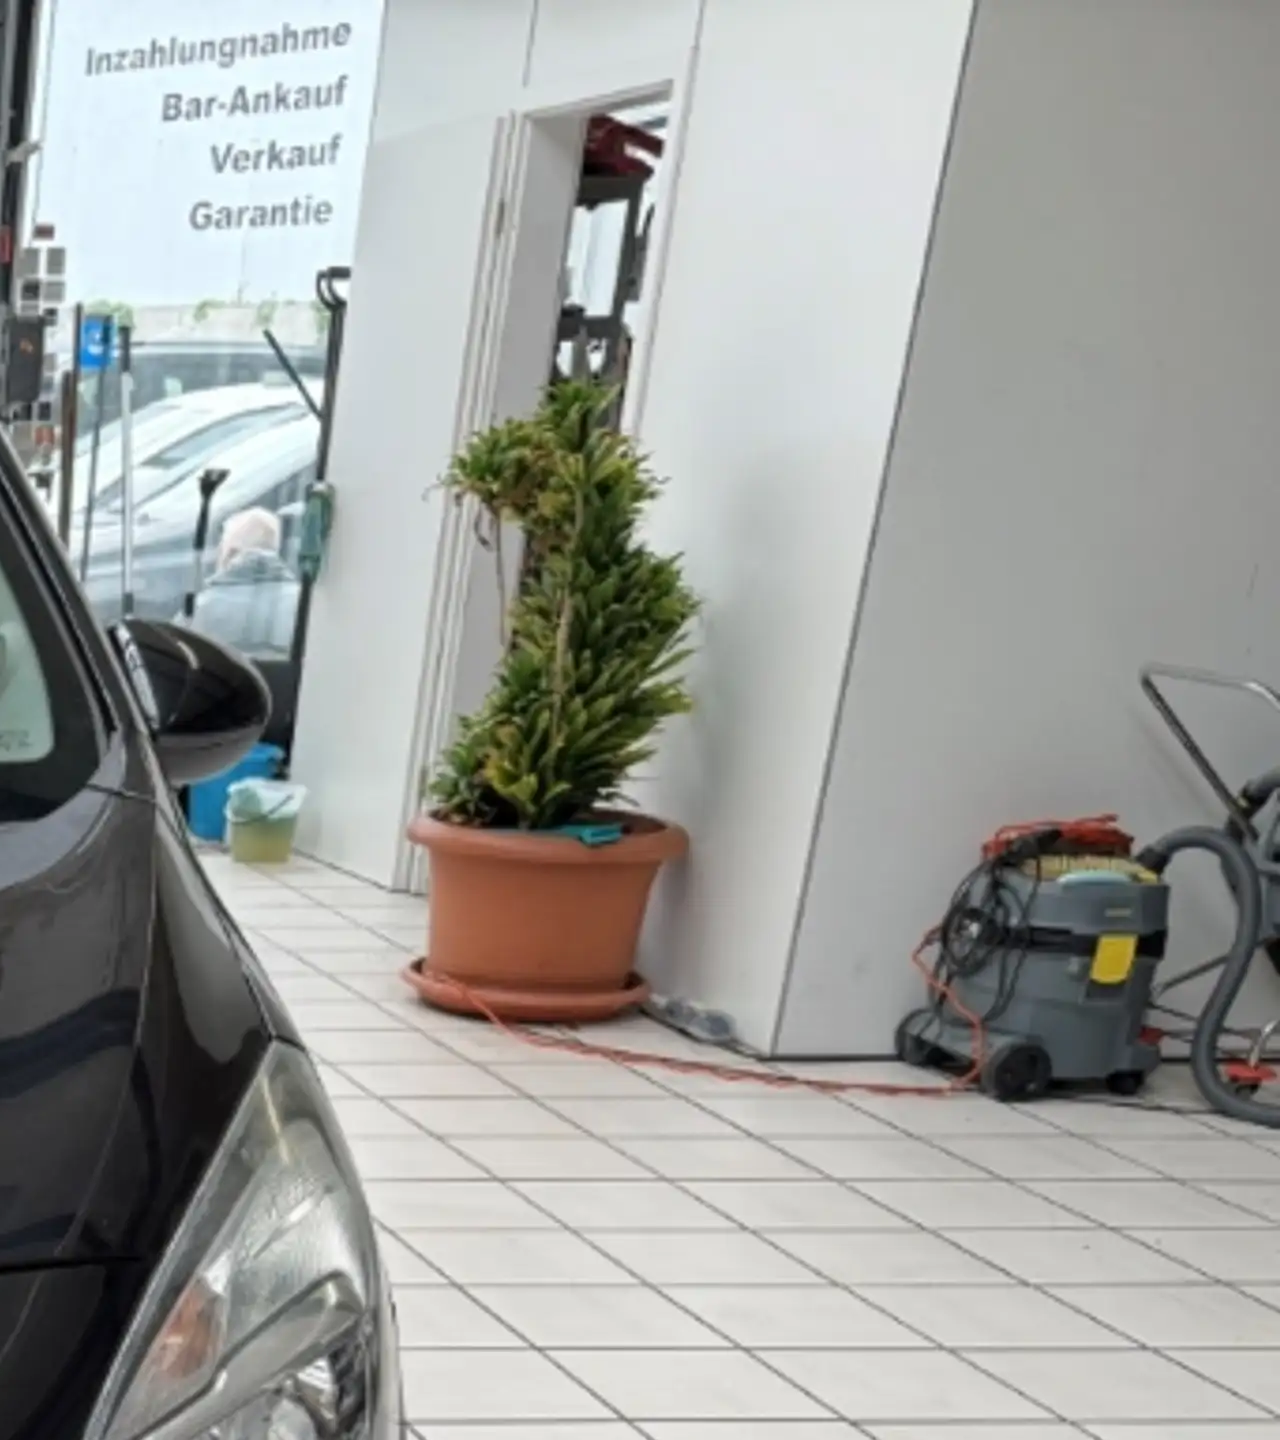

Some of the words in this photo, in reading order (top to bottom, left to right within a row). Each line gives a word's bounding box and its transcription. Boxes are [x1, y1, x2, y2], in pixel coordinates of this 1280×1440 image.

[85, 22, 352, 77] Inzahlungnahme
[162, 74, 348, 122] Bar-Ankauf
[210, 133, 342, 174] Verkauf
[189, 195, 334, 231] Garantie
